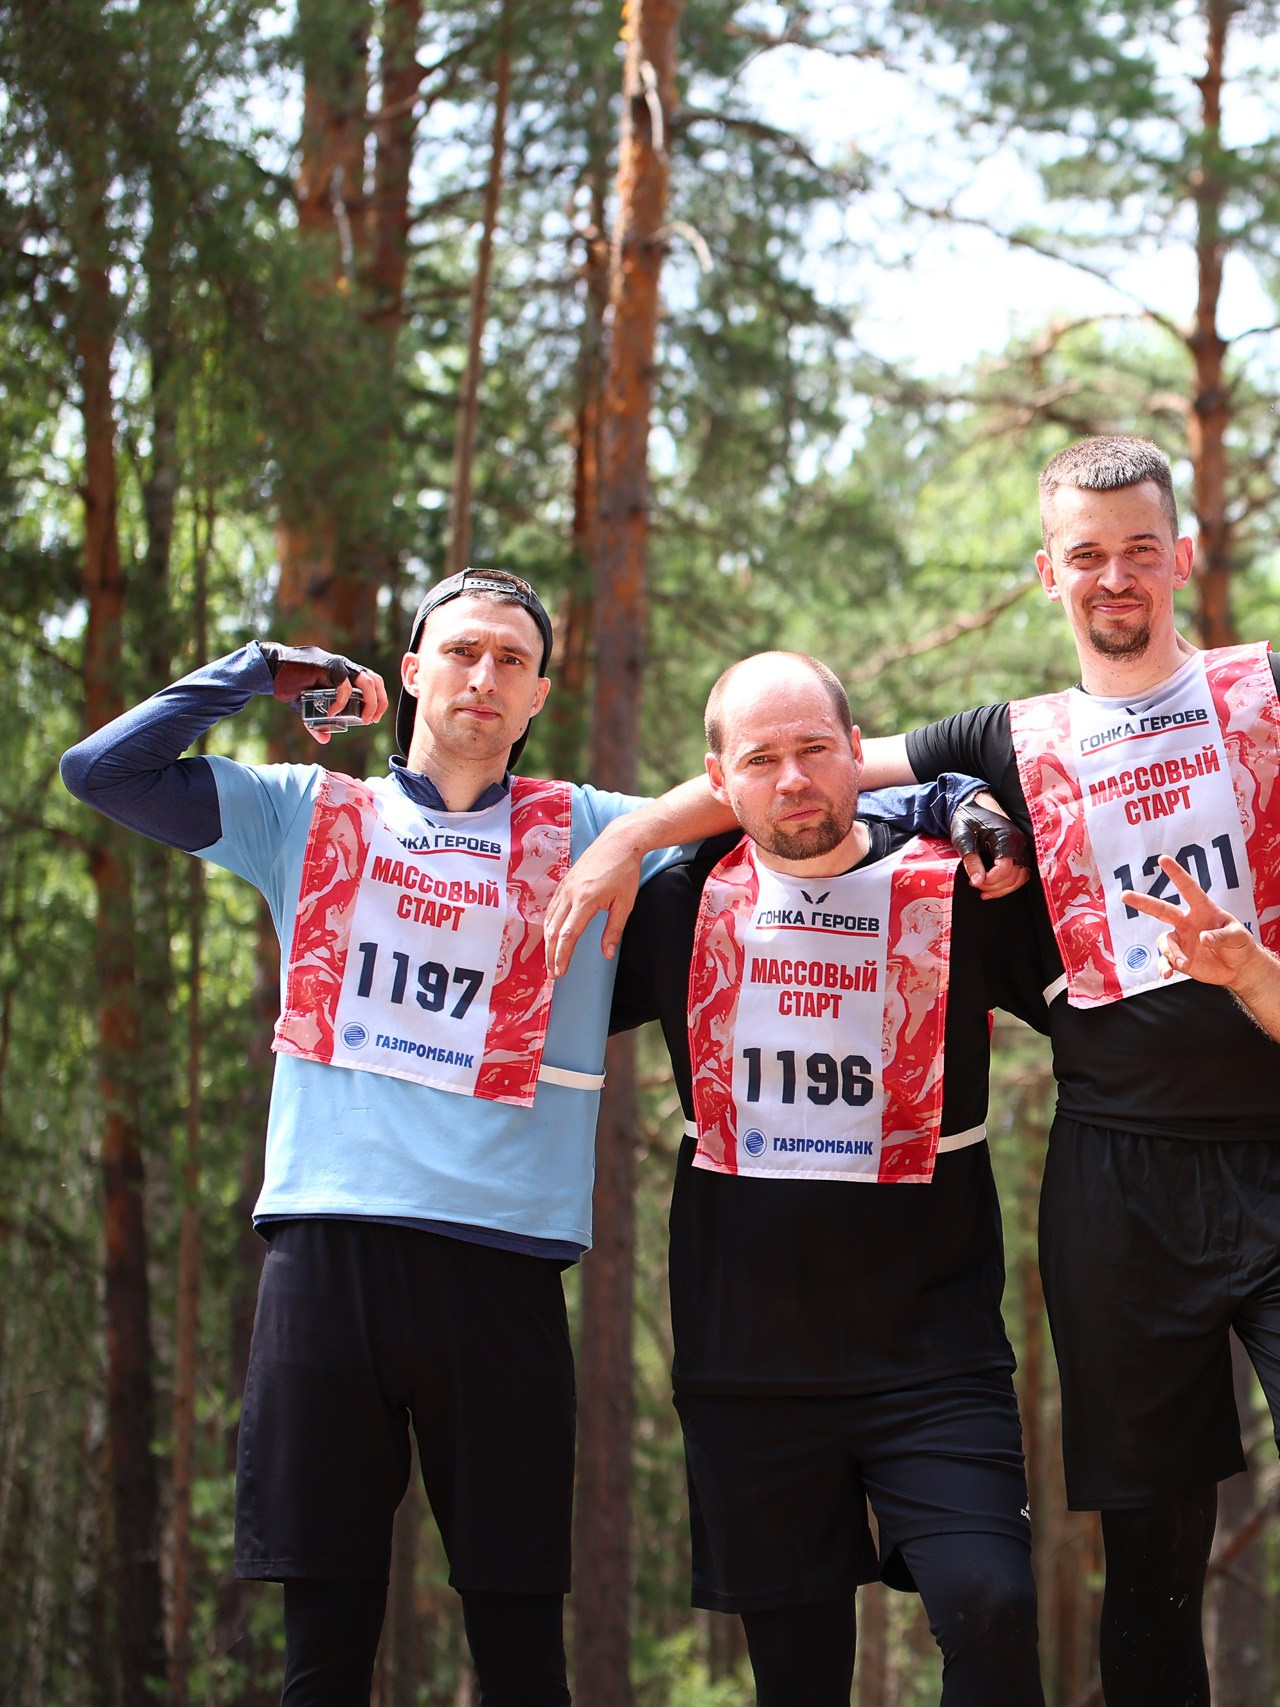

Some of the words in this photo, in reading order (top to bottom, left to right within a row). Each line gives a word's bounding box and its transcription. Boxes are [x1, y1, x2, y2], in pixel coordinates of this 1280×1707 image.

[1080, 723, 1135, 752] ГОНКА
[1140, 708, 1208, 732] ГЕРОЕВ
[1088, 744, 1221, 807] МАССОВЫЙ
[1124, 785, 1192, 826] СТАРТ
[396, 836, 431, 850] НКА
[434, 834, 502, 854] ГЕРОЕВ
[371, 856, 499, 908] МАССОВЫЙ
[1113, 834, 1240, 920] 1201
[397, 894, 465, 931] СТАРТ
[757, 910, 805, 926] ГОНКА
[811, 912, 880, 932] ГЕРОЕВ
[356, 942, 485, 1020] 1197
[750, 958, 878, 992] МАССОВЫЙ
[779, 991, 843, 1019] СТАРТ
[375, 1034, 475, 1069] ГАЗПРОМБАНК
[743, 1048, 874, 1107] 1196
[773, 1137, 874, 1156] ГАЗПРОМБАНК
